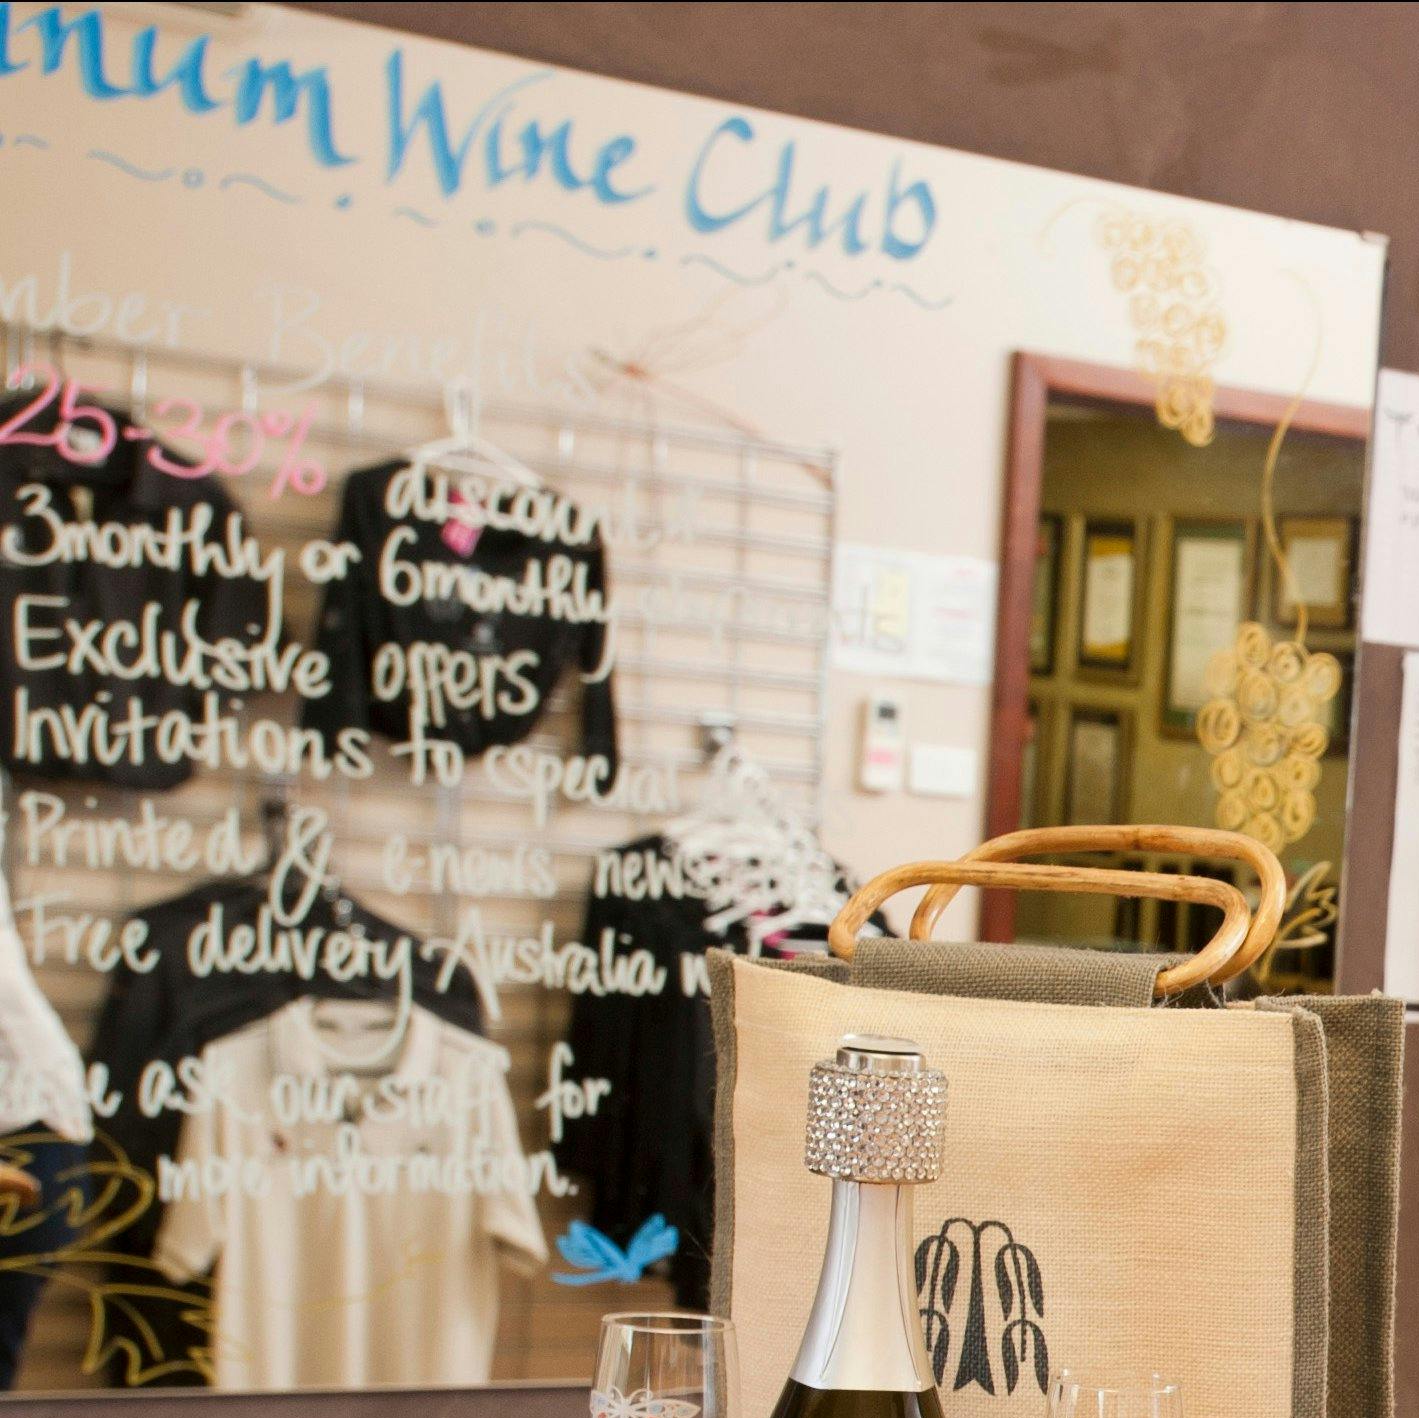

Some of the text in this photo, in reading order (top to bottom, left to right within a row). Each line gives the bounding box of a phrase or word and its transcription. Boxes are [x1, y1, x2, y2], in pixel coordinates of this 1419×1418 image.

[388, 48, 656, 203] Wine
[684, 116, 938, 262] Club
[0, 360, 328, 500] 25-30%
[2, 482, 286, 645] 3monthly
[300, 538, 363, 582] or
[378, 524, 618, 684] 6monthly
[13, 593, 542, 728] Exclusive offers
[13, 685, 375, 780] Invitations
[390, 700, 465, 788] to
[18, 790, 272, 875] Printed
[14, 888, 162, 976] Free
[188, 903, 414, 1065] delivery
[418, 905, 670, 1022] Australia
[270, 1073, 360, 1127] our
[533, 1040, 614, 1144] for
